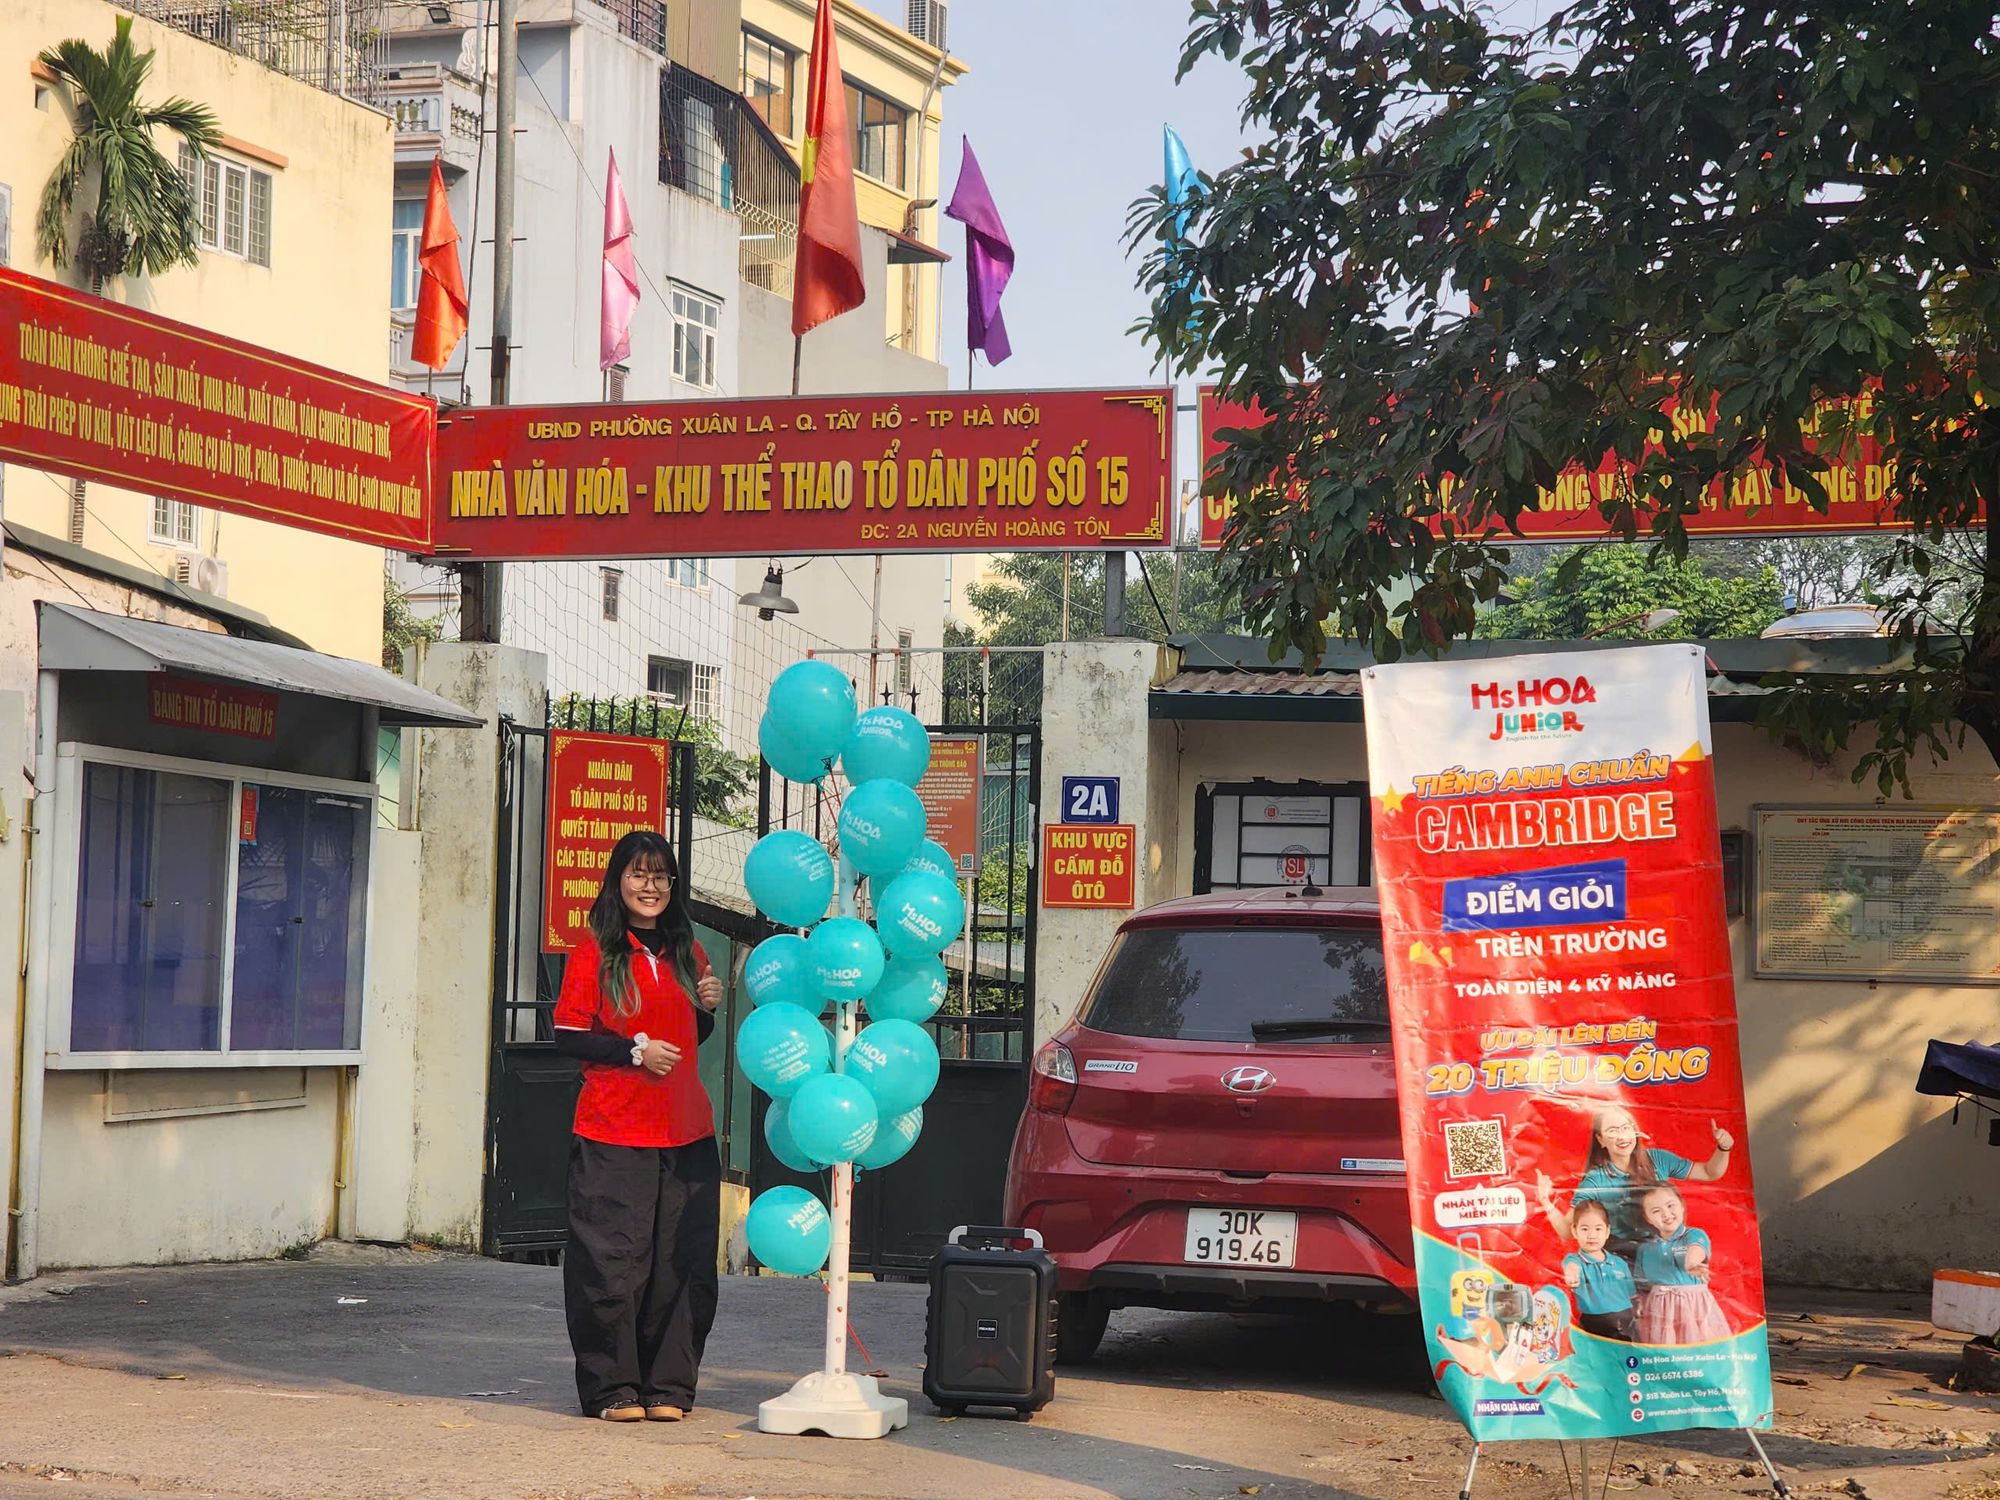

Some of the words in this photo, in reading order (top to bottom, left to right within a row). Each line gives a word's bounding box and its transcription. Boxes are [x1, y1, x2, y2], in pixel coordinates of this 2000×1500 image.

[19, 318, 47, 365] TOÀN
[49, 326, 71, 372] DÂN
[73, 334, 108, 382] KHÔNG
[110, 342, 129, 388] CHẾ
[131, 355, 151, 399] TẠO,
[154, 352, 173, 400] SẢN
[176, 360, 201, 411] XUẤT,
[203, 375, 224, 413] MUA
[225, 376, 246, 423] BÁN,
[249, 381, 271, 426] XUẤT
[299, 398, 318, 444] VẬN
[319, 402, 351, 448] CHUYỂN
[528, 422, 581, 440] UBND
[589, 414, 672, 438] PHƯỜNG
[682, 413, 737, 435] XUÂN
[745, 416, 774, 433] LA
[796, 413, 817, 431] Q.
[825, 409, 861, 431] TÂY
[872, 404, 902, 429] HỒ
[927, 411, 954, 427] TP
[963, 404, 995, 426] HÀ
[1003, 402, 1040, 429] NỘI
[23, 385, 46, 430] TRÁI
[49, 392, 76, 436] PHÉP
[78, 397, 92, 440] VŨ
[116, 407, 135, 457] VẬT
[136, 413, 157, 462] LIỆU
[178, 423, 203, 468] CÔNG
[206, 435, 218, 479] CỤ
[282, 449, 310, 493] THUỐC
[311, 459, 333, 500] PHÁO
[335, 463, 346, 503] VÀ
[360, 475, 379, 510] CHƠI
[380, 479, 400, 515] NGUY
[402, 475, 421, 519] HIỂM
[450, 459, 508, 518] NHÀ
[513, 459, 567, 516] VĂN
[575, 457, 629, 515] HÓA
[636, 484, 647, 494] -
[653, 464, 711, 513] KHU
[720, 442, 776, 512] THỂ
[780, 461, 854, 510] THAO
[862, 439, 901, 509] TỔ
[907, 448, 969, 508] DÂN
[978, 439, 1040, 507] PHỐ
[1045, 439, 1089, 507] SỐ
[1096, 456, 1129, 505] 15
[860, 524, 889, 540] ĐC:
[896, 523, 918, 539] 2A
[927, 515, 998, 538] NGUYỄN
[1004, 517, 1066, 536] HOÀNG
[1073, 516, 1110, 536] TÔN
[153, 681, 181, 721] BẢNG
[184, 695, 200, 724] TIN
[203, 688, 216, 726] TỔ
[220, 697, 241, 730] DÂN
[244, 698, 263, 733] PHỐ
[263, 710, 274, 736] 15
[588, 759, 613, 780] NHÂN
[614, 760, 633, 781] DÂN
[1413, 765, 1498, 799] TIẾNG
[1499, 763, 1564, 791] ANH
[1568, 749, 1671, 785] CHUẨN
[570, 783, 583, 808] TỔ
[583, 787, 602, 809] DÂN
[603, 787, 621, 810] PHỐ
[623, 788, 635, 811] SỐ
[637, 794, 647, 812] 15
[1071, 785, 1109, 816] 2A
[560, 815, 589, 838] QUYẾT
[590, 818, 609, 840] TÂM
[1416, 790, 1677, 853] CAMBRIDGE
[1051, 832, 1088, 848] KHU
[1092, 832, 1128, 852] VỰC
[557, 846, 575, 867] CÁC
[576, 847, 595, 868] TIÊU
[1054, 853, 1095, 875] CẤM
[1100, 854, 1124, 875] ĐỖ
[1287, 858, 1304, 874] SL
[563, 877, 599, 898] PHƯỜNG
[1072, 880, 1105, 899] ÔTÔ
[1466, 882, 1542, 915] ĐIỂM
[1548, 878, 1614, 911] GIỎI
[568, 907, 581, 928] ĐÔ
[1475, 931, 1543, 958] TRÊN
[1550, 926, 1668, 955] TRƯỜNG
[1454, 979, 1510, 998] TOÀN
[1514, 977, 1562, 999] DIỆN
[1569, 979, 1581, 992] 4
[1586, 973, 1611, 992] KỸ
[1617, 971, 1676, 991] NĂNG
[1480, 1030, 1519, 1051] ƯU
[1560, 1022, 1604, 1046] LÊN
[1606, 1016, 1658, 1044] ĐẾN
[1426, 1062, 1475, 1096] 20
[1480, 1050, 1589, 1092] TRIỆU
[1593, 1042, 1710, 1084] ĐỒNG
[1442, 1198, 1475, 1210] NHẬN
[1459, 1207, 1487, 1219] MIỄN
[1218, 1211, 1265, 1236] 30K
[1196, 1237, 1281, 1263] 919.46
[1644, 1373, 1661, 1382] 024
[1476, 1401, 1501, 1414] NHẬN
[1500, 1401, 1519, 1412] QUÀ
[1519, 1402, 1540, 1412] NGAY
